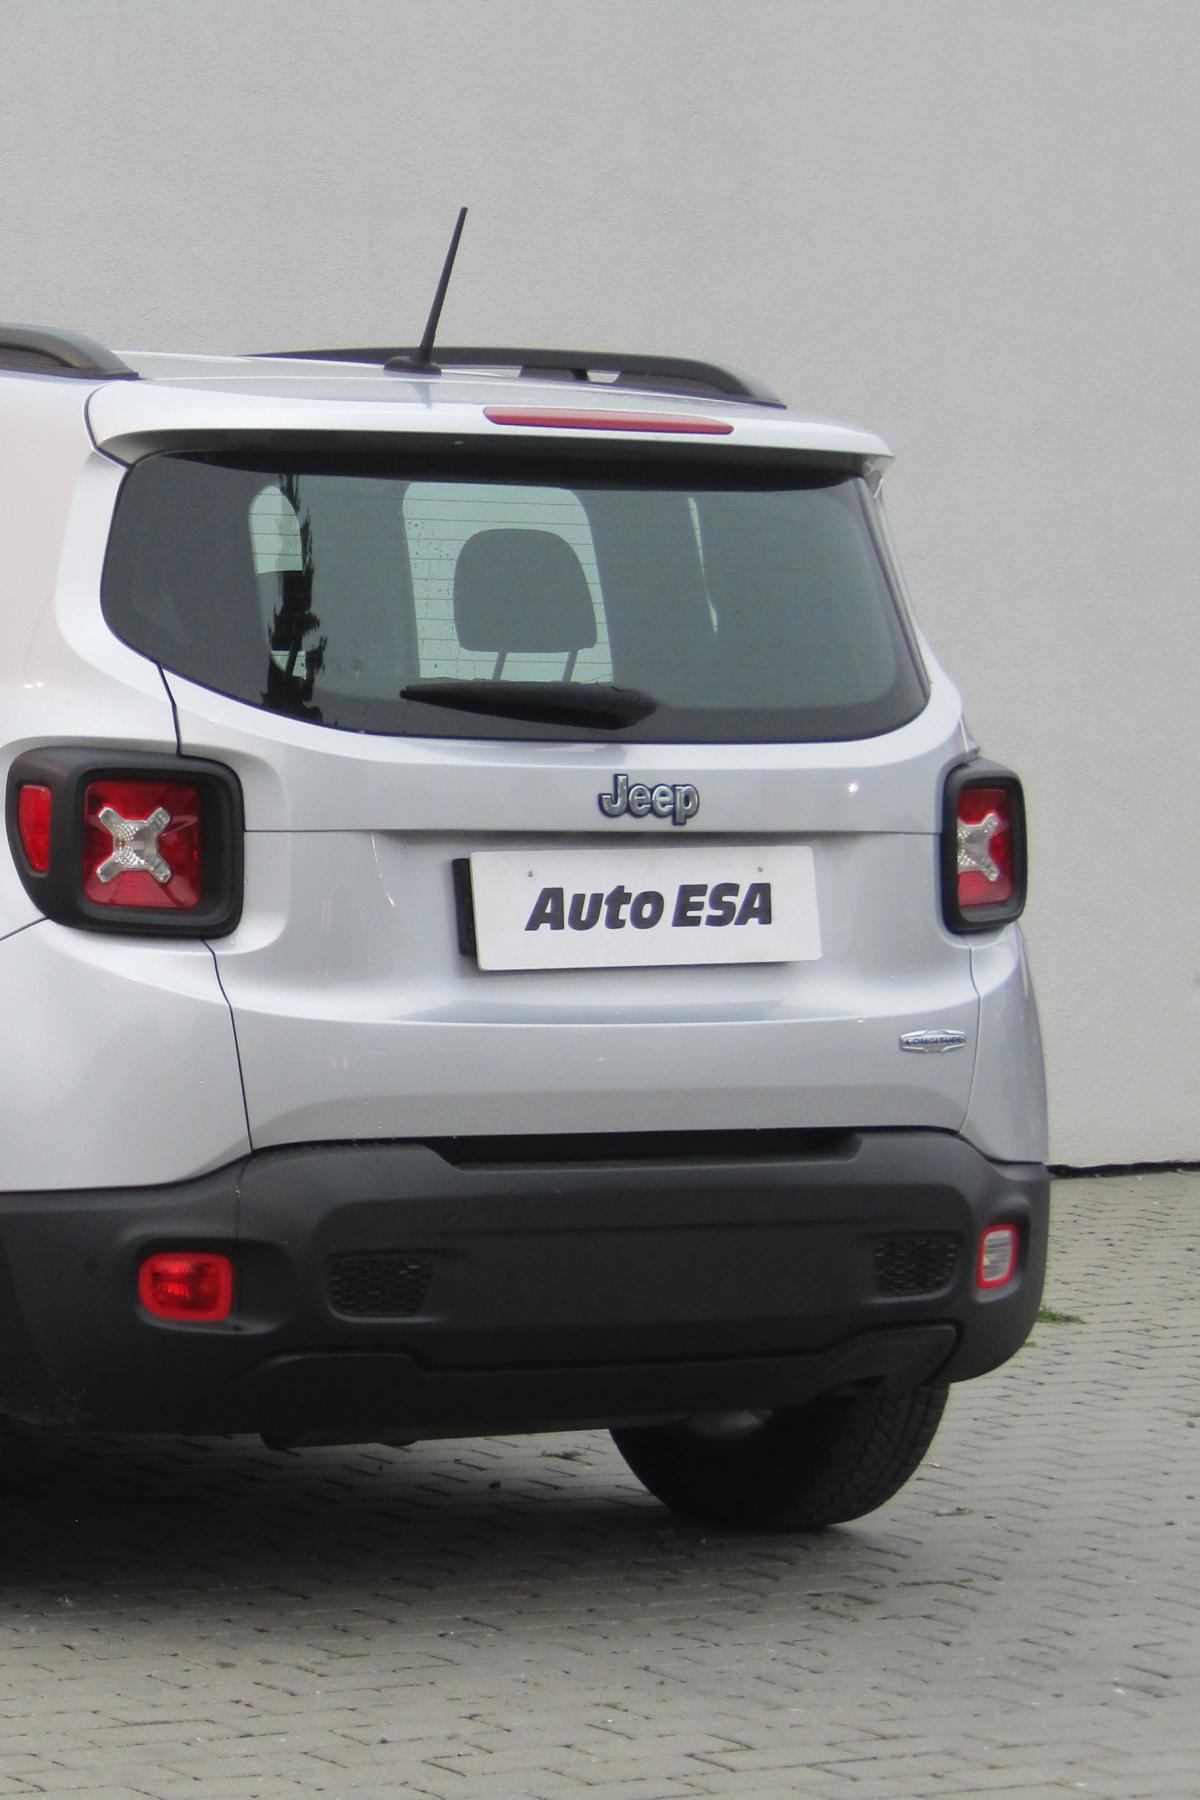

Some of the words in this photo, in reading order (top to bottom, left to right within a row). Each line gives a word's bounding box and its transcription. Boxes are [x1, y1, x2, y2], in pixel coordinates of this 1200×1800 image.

[599, 774, 699, 825] Jeep
[525, 885, 664, 931] Auto
[671, 882, 773, 927] ESA
